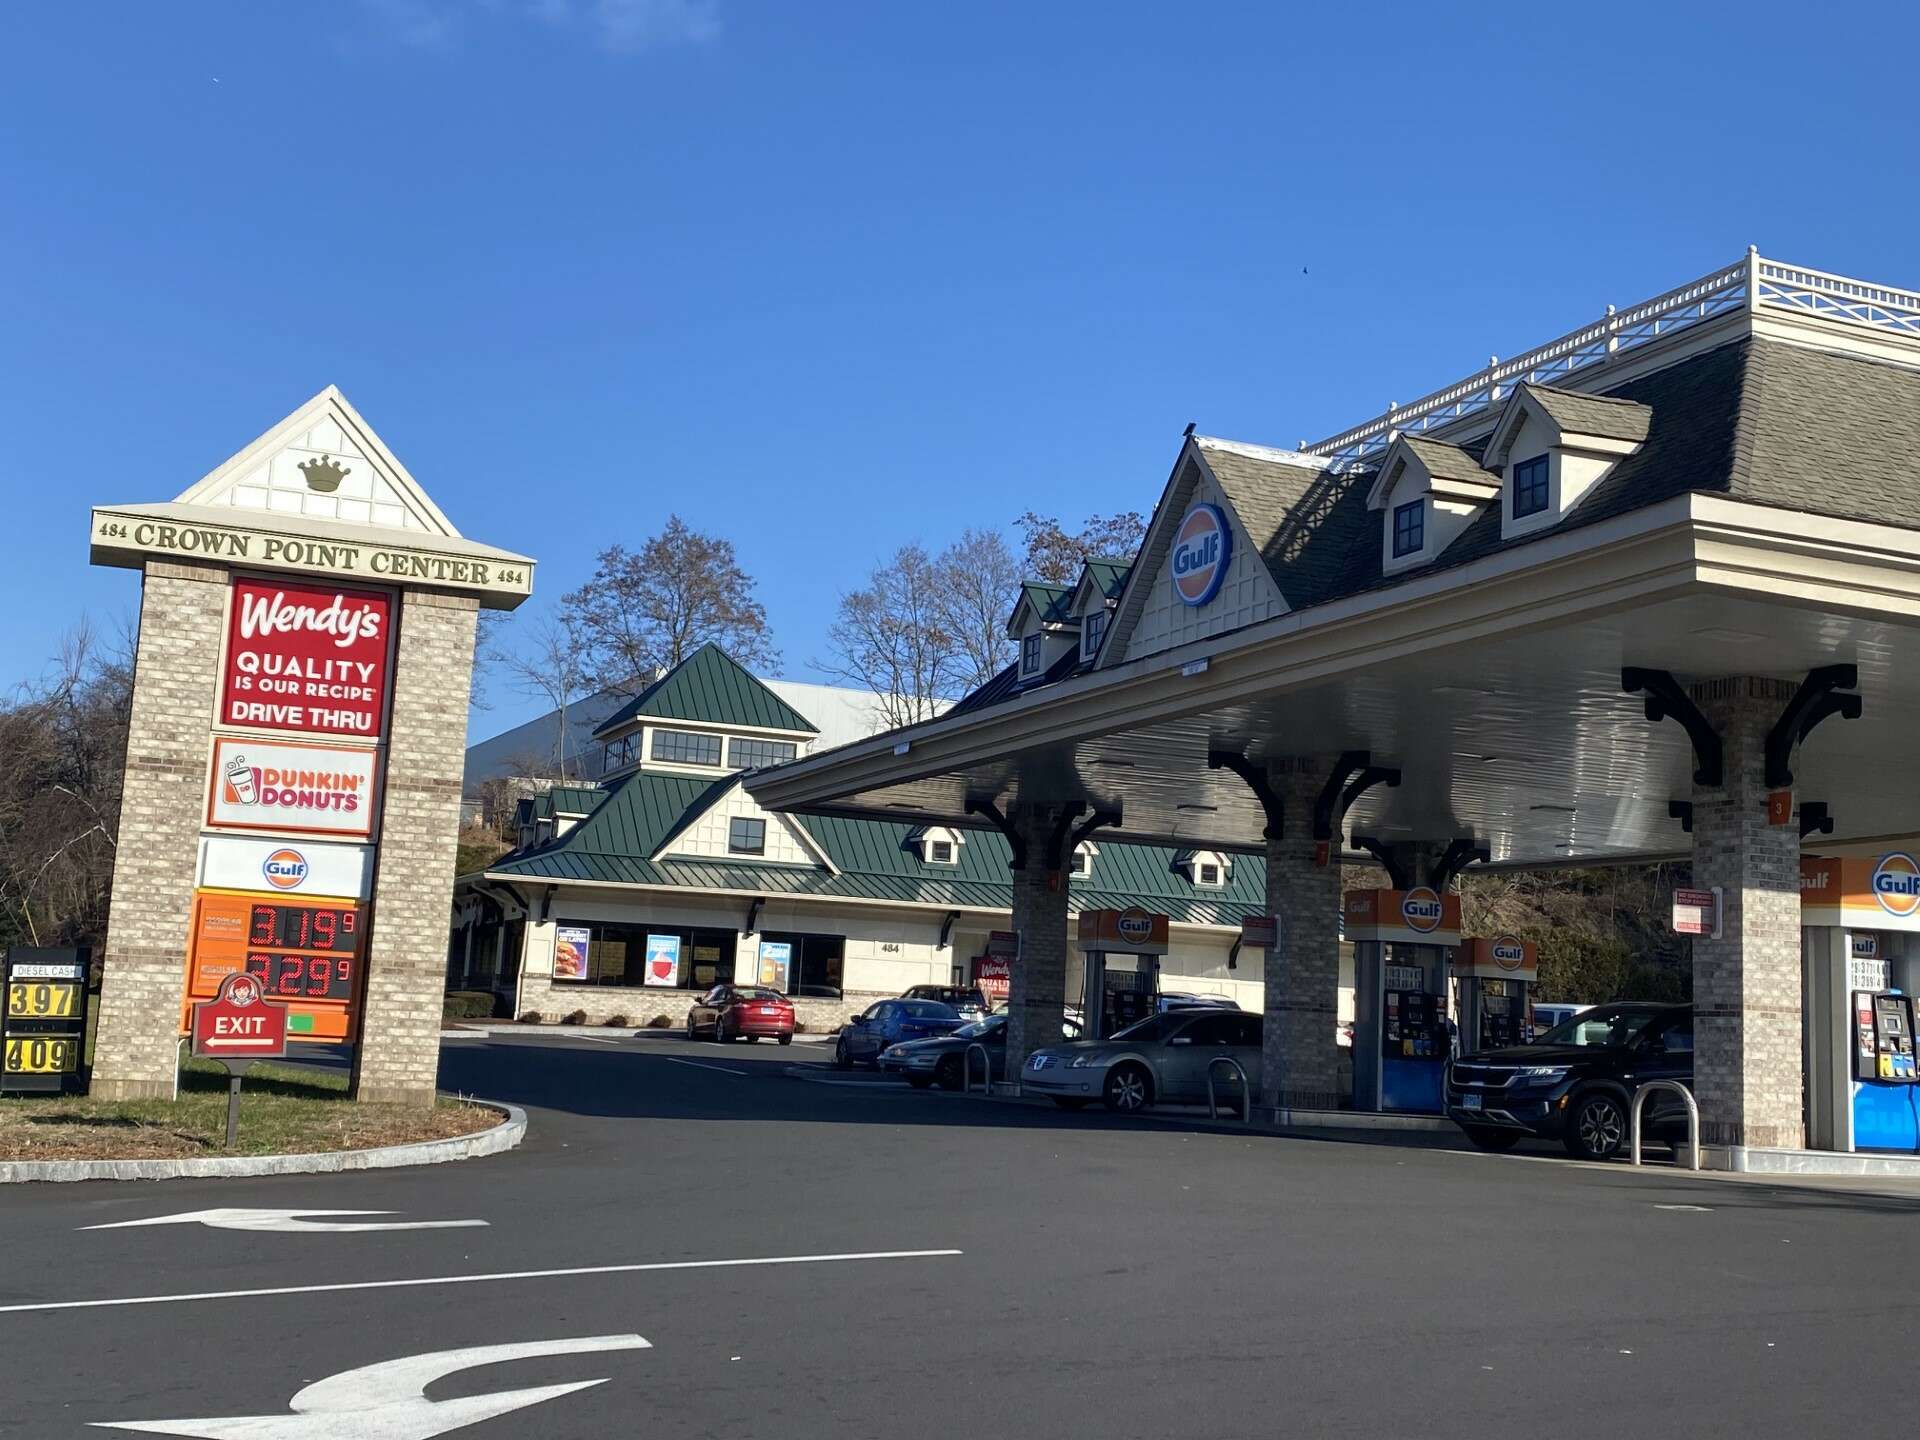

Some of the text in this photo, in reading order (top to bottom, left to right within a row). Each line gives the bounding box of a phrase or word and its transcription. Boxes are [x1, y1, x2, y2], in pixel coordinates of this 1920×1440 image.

[99, 523, 523, 584] 484 CROWN POINT CENTER 484
[1174, 532, 1218, 574] Gulf
[241, 592, 381, 647] Wendy's
[236, 651, 376, 684] QUALITY
[235, 675, 373, 701] IS OUR RECIPE
[231, 700, 372, 730] DRIVE THRU
[263, 768, 365, 791] DUNKIN'
[262, 788, 358, 811] DONUTS
[1776, 803, 1782, 814] 3
[266, 862, 304, 876] Gulf
[1876, 873, 1920, 894] Gulf
[1405, 901, 1441, 917] Gulf
[1120, 919, 1151, 932] Gulf
[882, 944, 899, 953] 484
[1494, 947, 1523, 959] Gulf
[1853, 940, 1874, 953] ulf
[18, 967, 49, 976] DIESEL
[981, 963, 1010, 979] Wendy
[215, 1016, 267, 1034] EXIT
